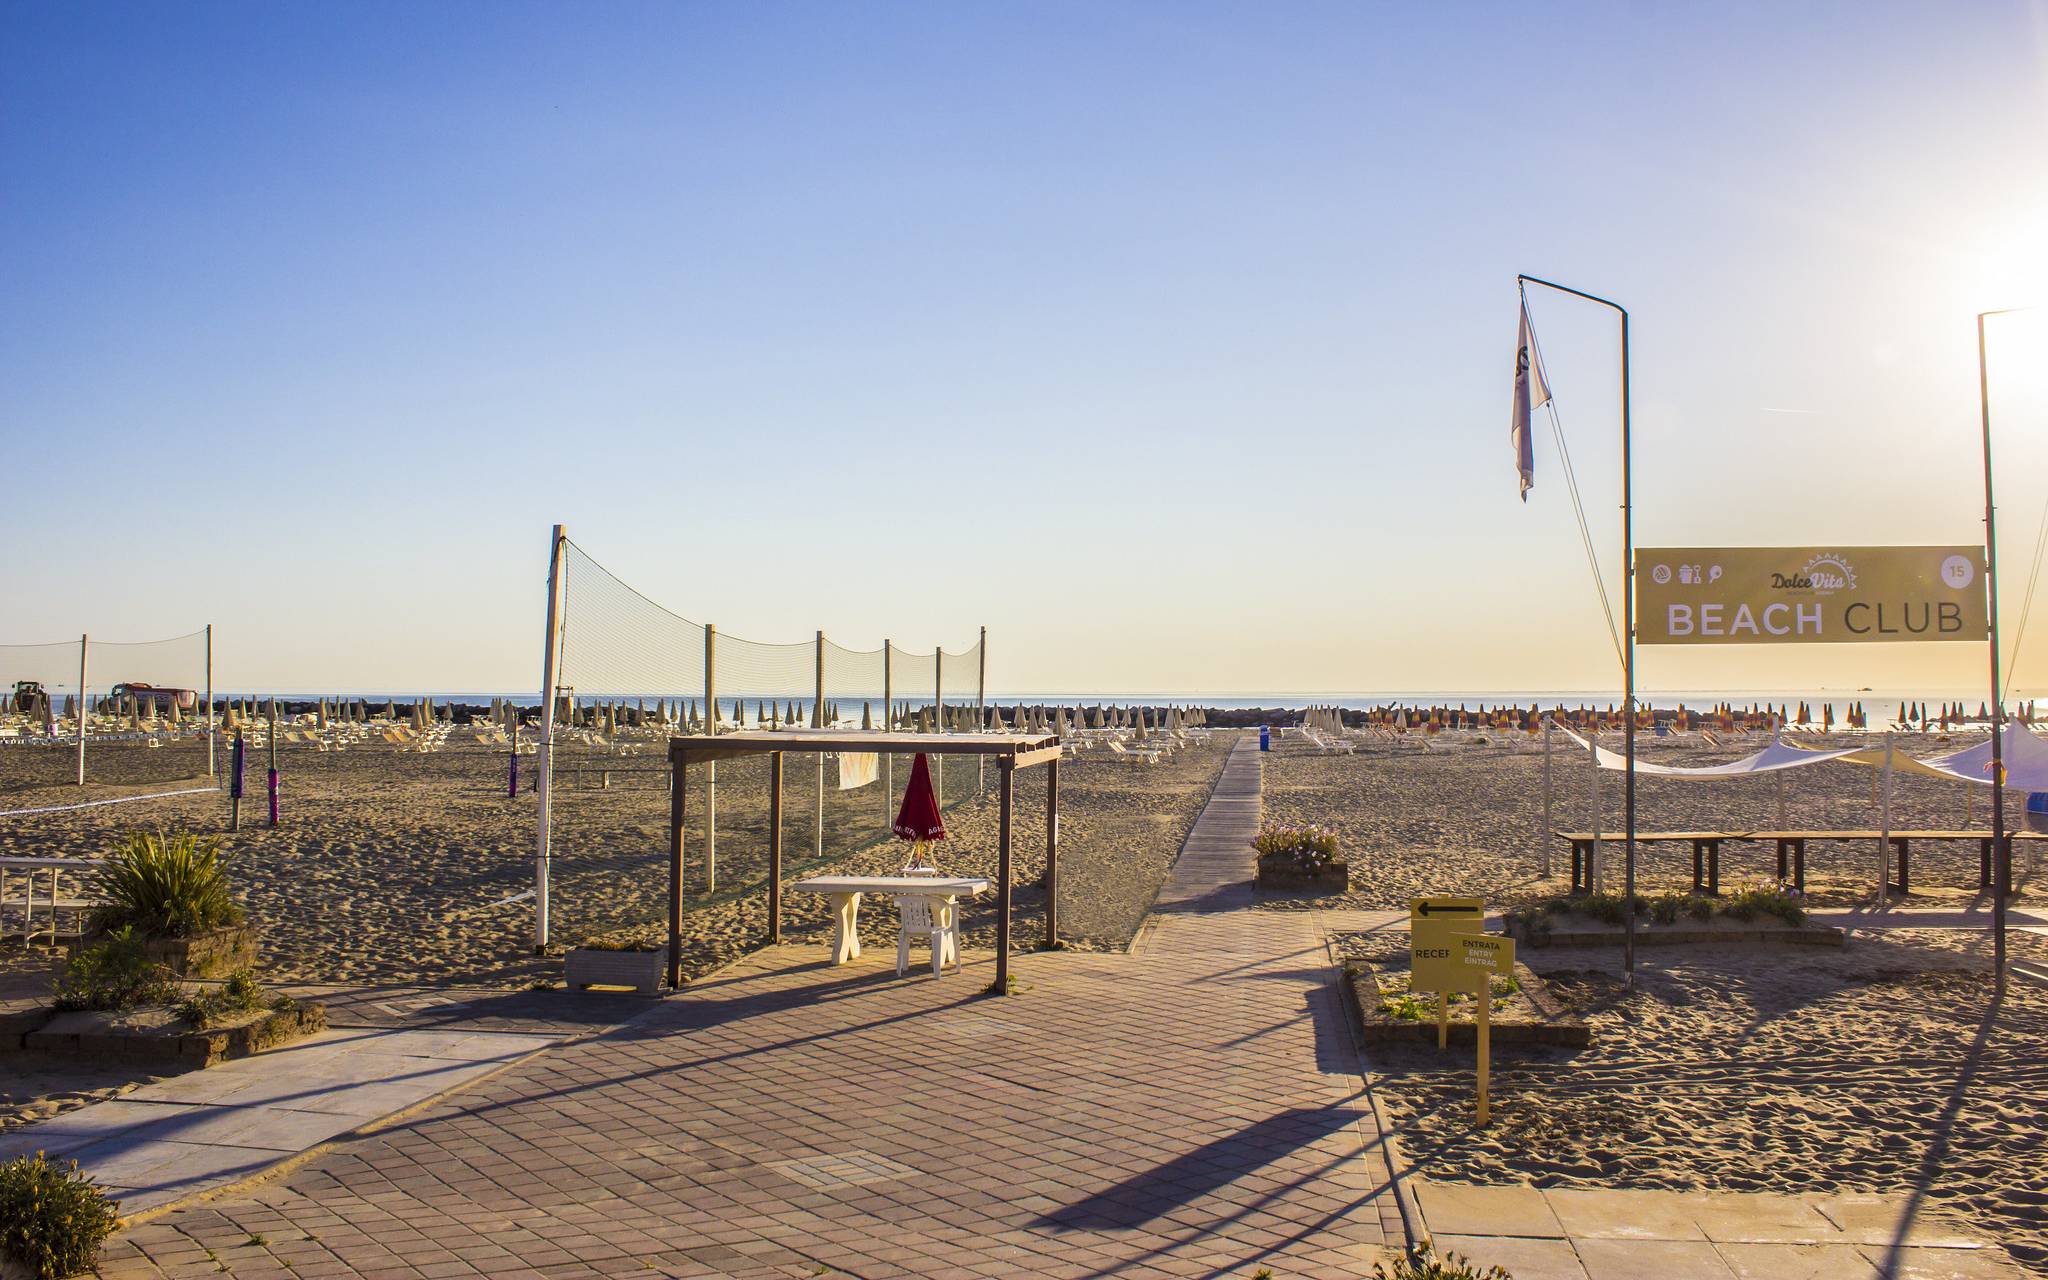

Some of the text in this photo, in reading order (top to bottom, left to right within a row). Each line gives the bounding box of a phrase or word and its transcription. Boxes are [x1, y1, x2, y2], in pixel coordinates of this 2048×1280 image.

[1950, 565, 1965, 578] 15
[1667, 602, 1963, 636] BEACH CLUB
[1462, 940, 1500, 950] ENTRATA
[1469, 949, 1493, 957] ENTRY
[1464, 957, 1497, 967] EINTRAG
